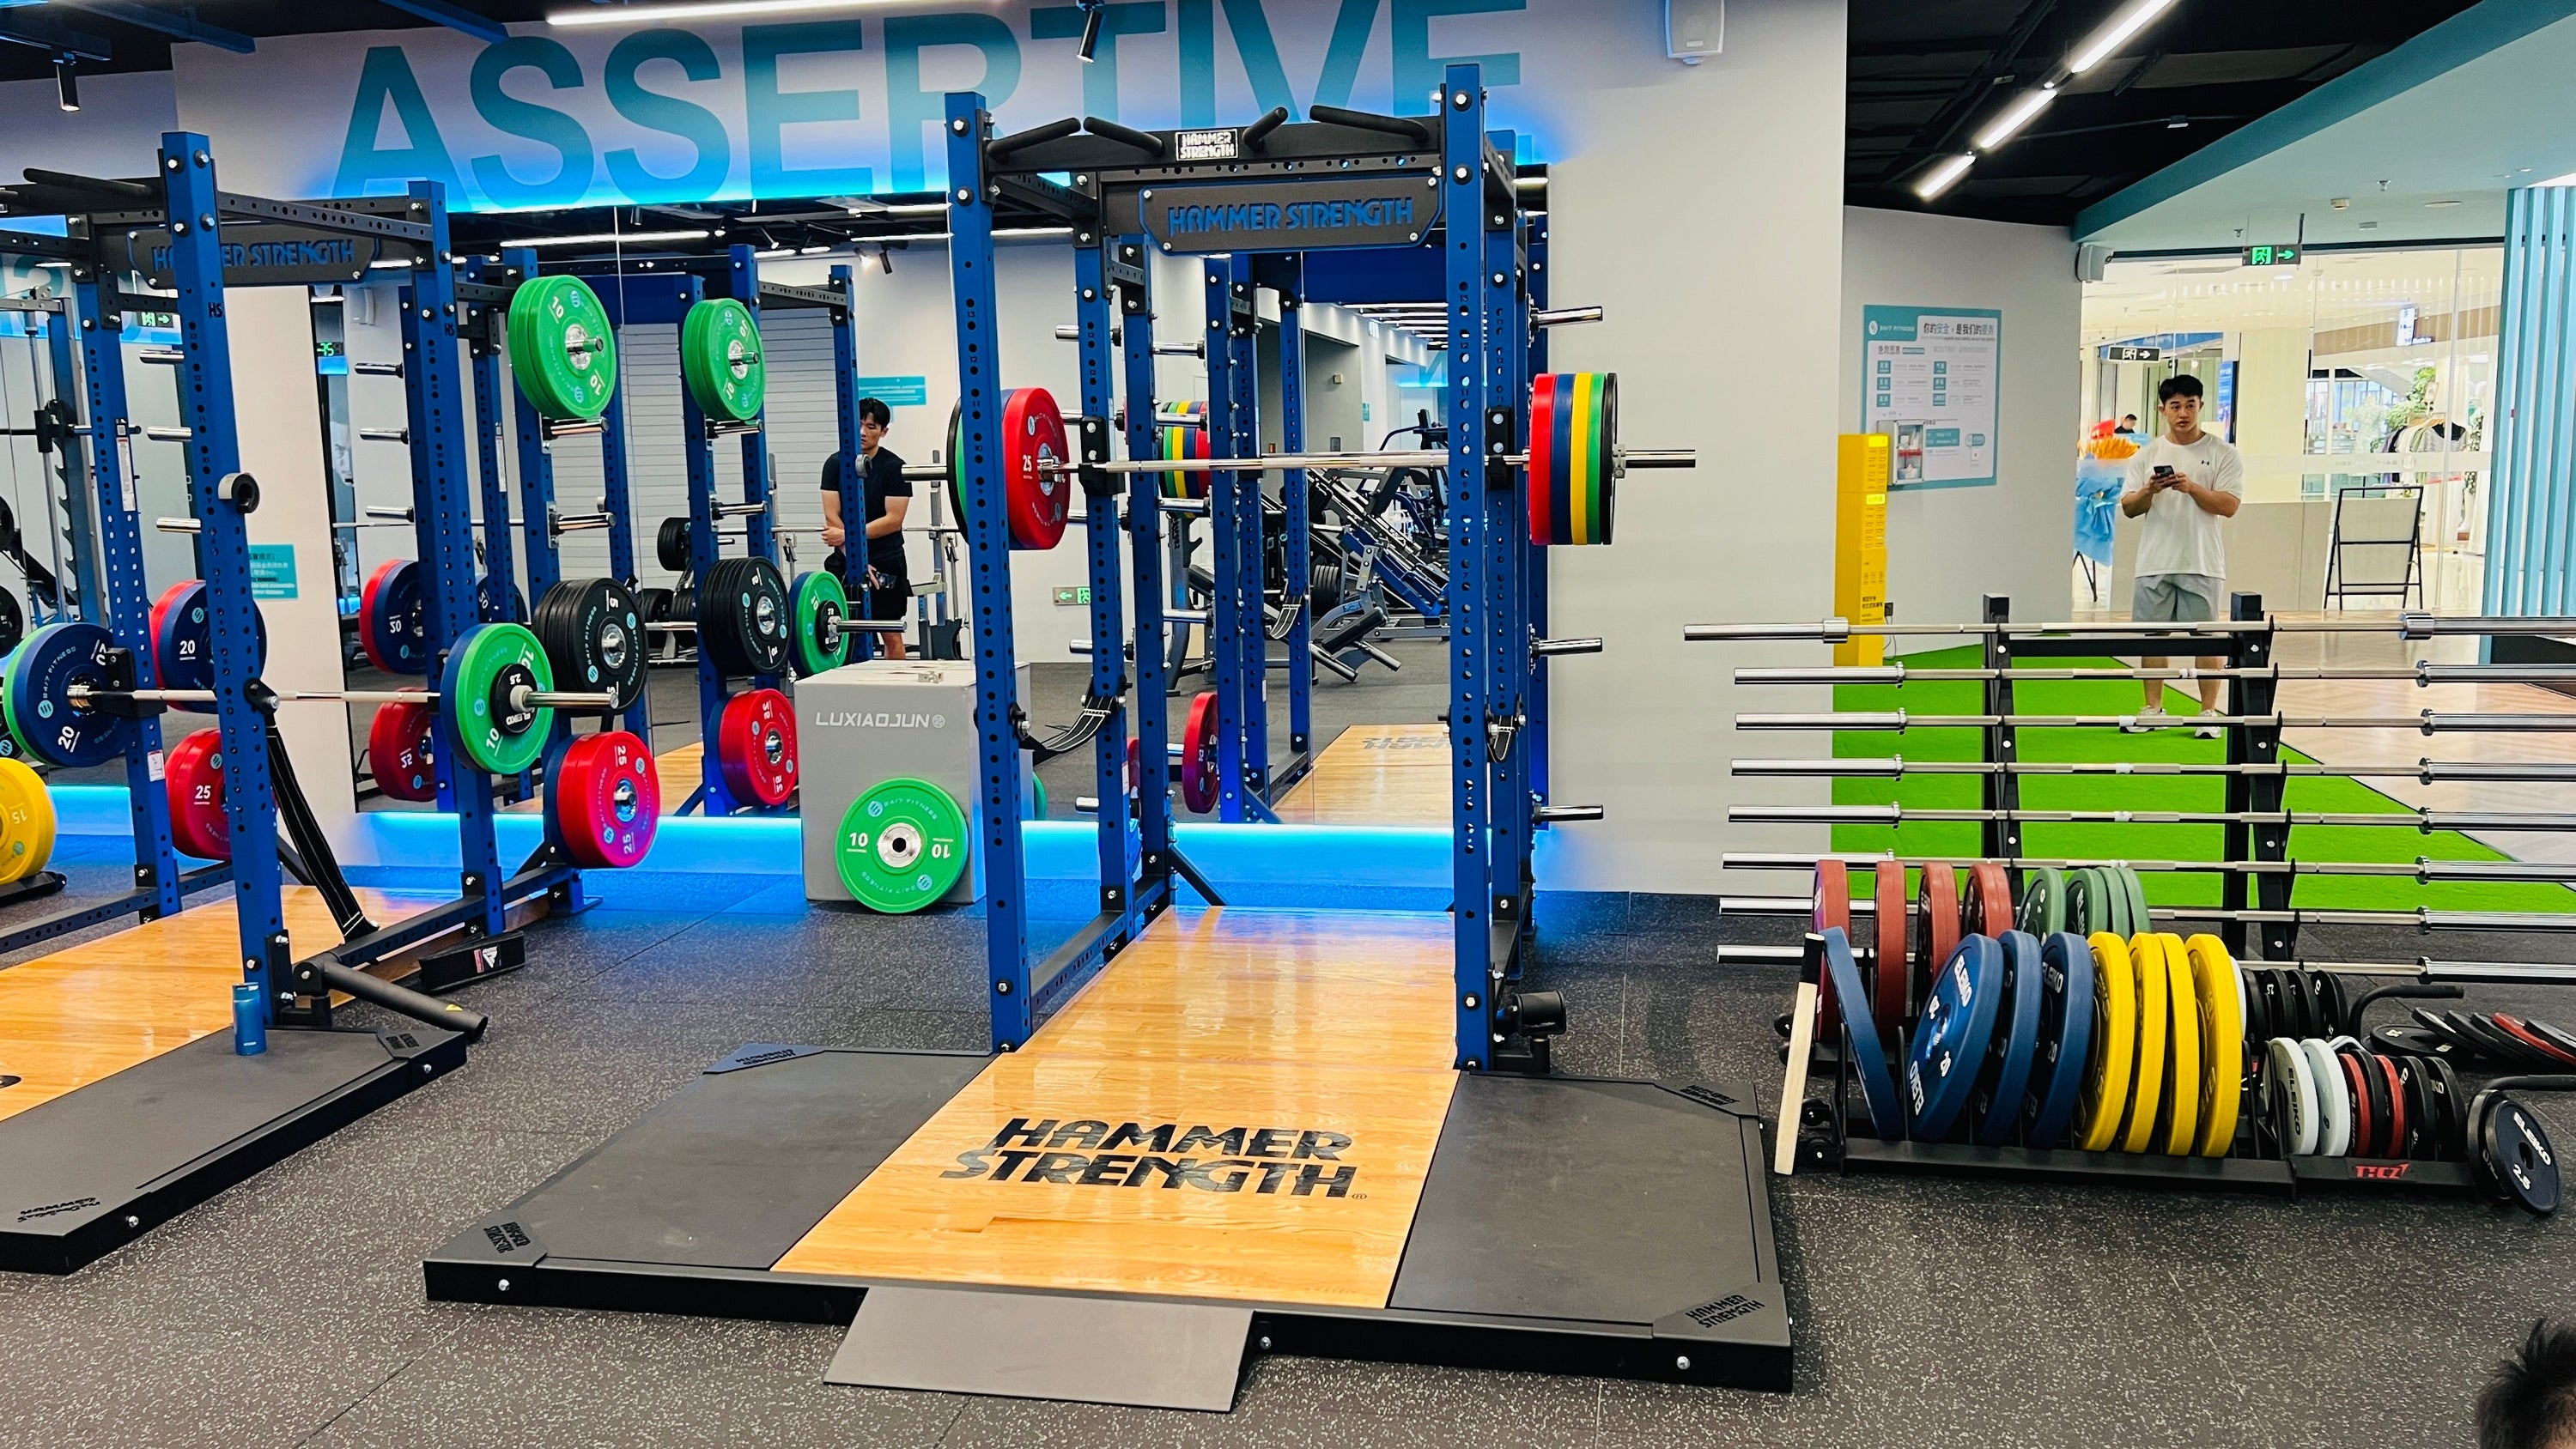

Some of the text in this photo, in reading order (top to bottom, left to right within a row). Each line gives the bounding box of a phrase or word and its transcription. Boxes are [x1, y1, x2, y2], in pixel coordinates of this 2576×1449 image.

[331, 0, 1531, 210] ASSERTIVE
[1182, 131, 1231, 147] HAMMER
[1180, 143, 1235, 160] STRENGTH
[1168, 197, 1413, 238] HAMMER STRENGTH
[248, 239, 355, 267] STRENGTH
[209, 302, 223, 318] HS
[552, 296, 564, 318] 10
[1023, 454, 1032, 472] 25
[609, 597, 618, 608] 5
[179, 640, 196, 654] 20
[816, 712, 930, 729] LUXIAOJUN
[58, 725, 75, 749] 20
[486, 727, 500, 749] 10
[617, 745, 628, 766] 25
[195, 785, 211, 799] 25
[906, 798, 939, 821] FITNESS
[623, 834, 632, 854] 25
[849, 832, 869, 847] 10
[932, 843, 951, 859] 10
[2287, 1067, 2301, 1137] ELEIKO
[987, 1118, 1353, 1161] HAMMER
[2513, 1112, 2551, 1166] ELEIKO
[939, 1150, 1358, 1198] STRENGTH
[2512, 1163, 2531, 1190] 2.5
